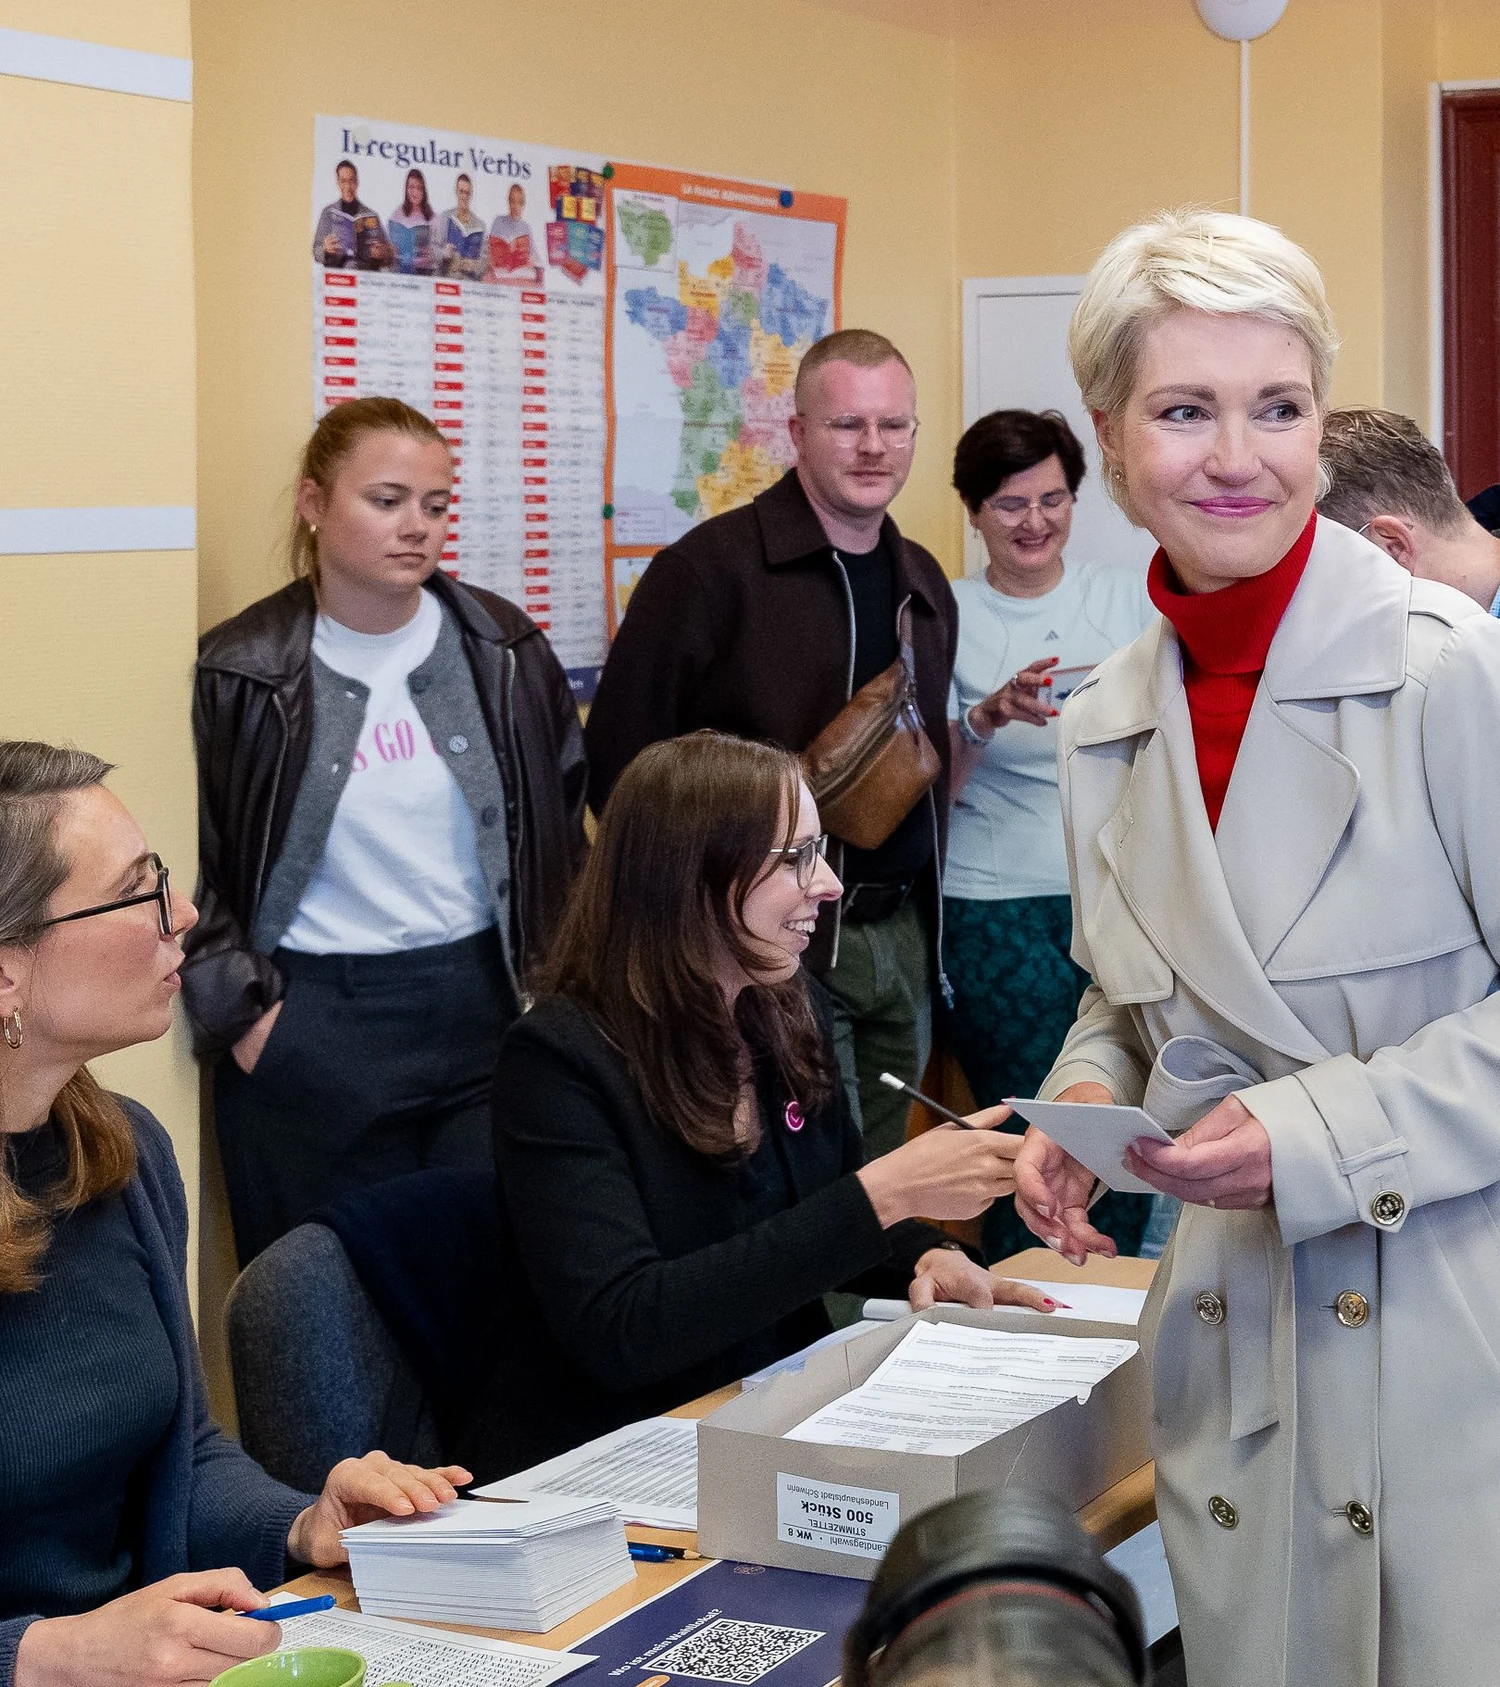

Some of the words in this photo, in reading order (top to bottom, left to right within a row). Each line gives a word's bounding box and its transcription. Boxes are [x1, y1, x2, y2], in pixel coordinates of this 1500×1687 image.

[471, 147, 532, 179] Verbs
[374, 718, 415, 762] GO
[787, 1484, 819, 1498] Schwerin
[801, 1500, 842, 1519] Stück
[821, 1492, 889, 1510] Landeshauptstadt
[846, 1509, 874, 1524] 500
[787, 1527, 794, 1536] 8
[797, 1530, 813, 1541] WK
[808, 1518, 867, 1537] STIMMZETTEL
[830, 1536, 888, 1554] Landtagswahl
[608, 1664, 631, 1676] Wo
[625, 1652, 648, 1666] ist
[644, 1640, 672, 1657] mein
[666, 1608, 722, 1641] Wahllokal?
